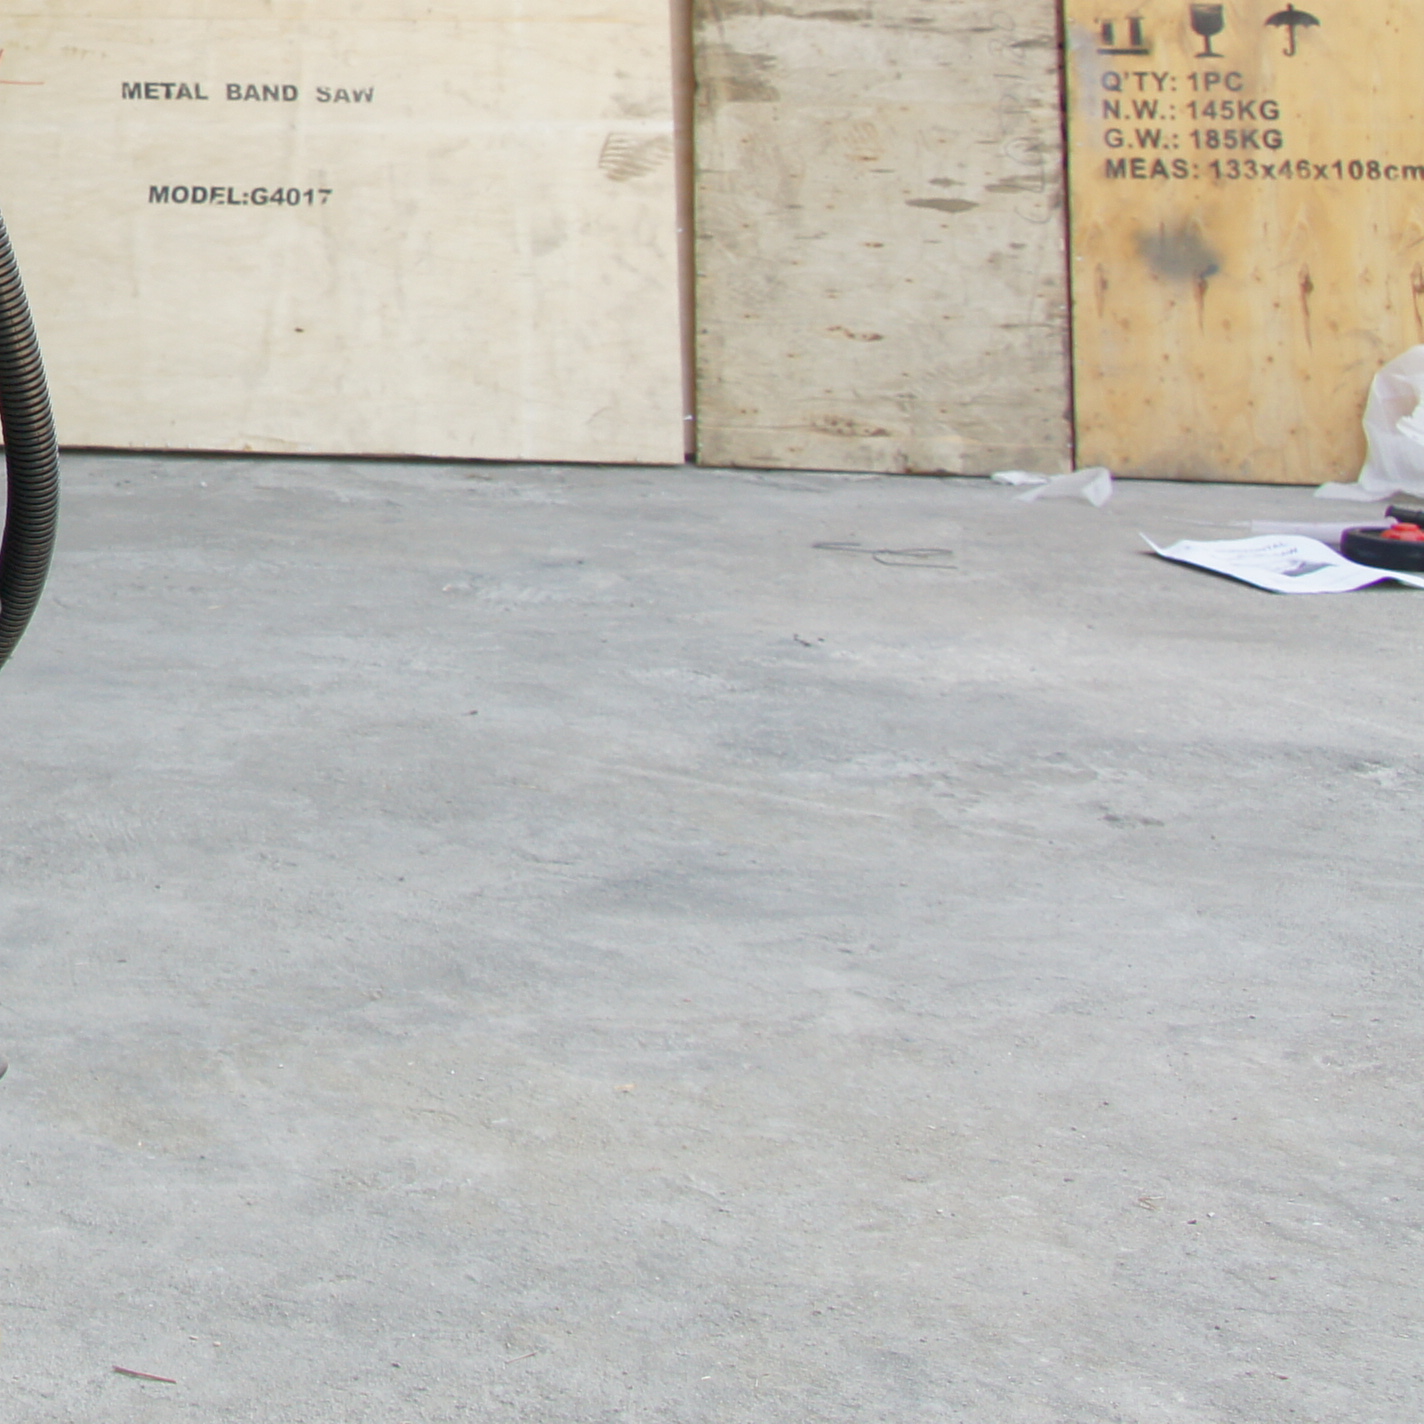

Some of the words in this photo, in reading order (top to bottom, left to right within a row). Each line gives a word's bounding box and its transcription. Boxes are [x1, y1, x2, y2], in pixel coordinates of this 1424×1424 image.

[121, 82, 209, 101] METAL
[226, 83, 298, 102] BAND
[316, 86, 374, 103] SAW
[1101, 72, 1177, 92] Q'TY:
[1188, 72, 1244, 92] 1PC
[1102, 100, 1177, 121] N.W.:
[1187, 100, 1280, 121] 145KG
[1104, 129, 1180, 149] G.W.:
[1189, 129, 1283, 150] 185KG
[1105, 158, 1199, 180] MEAS:
[148, 186, 333, 206] MODEL:G4017
